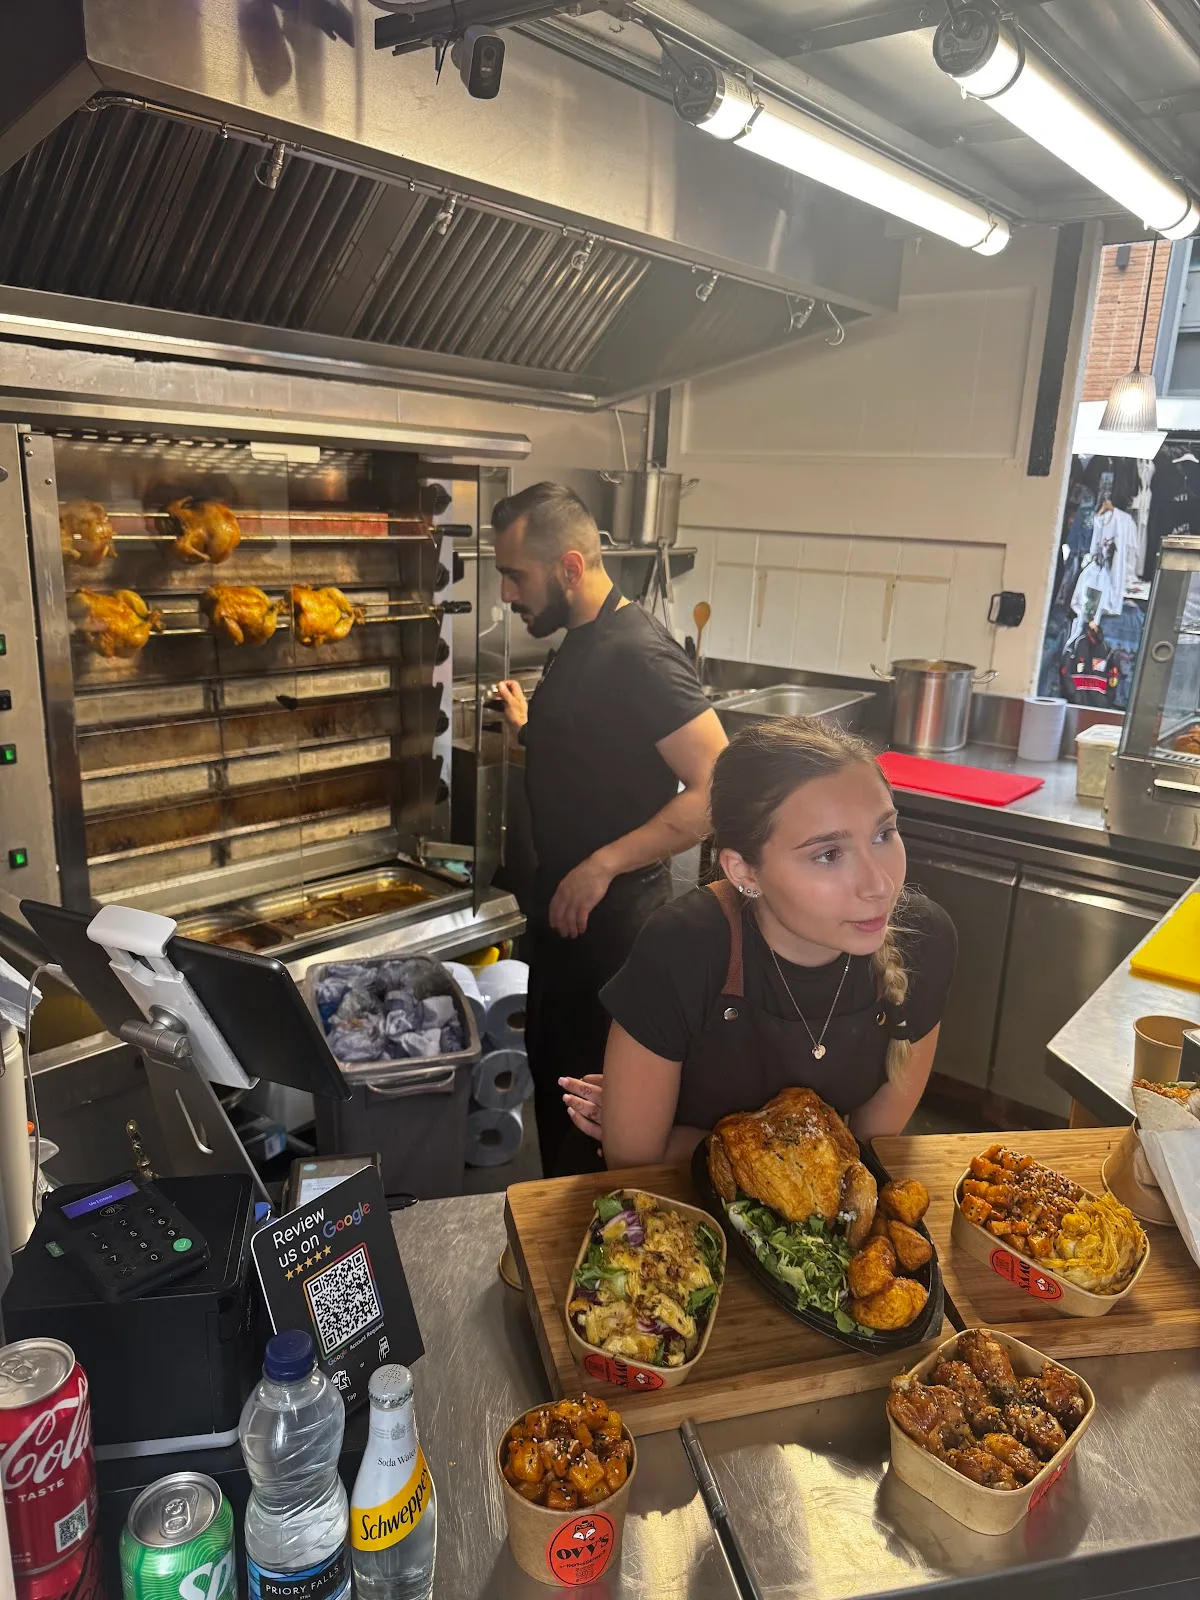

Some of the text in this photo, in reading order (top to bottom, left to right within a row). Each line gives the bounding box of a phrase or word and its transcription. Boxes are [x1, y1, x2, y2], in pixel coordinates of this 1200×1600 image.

[272, 1207, 325, 1249] Review
[278, 1201, 371, 1268] us on Google
[327, 1321, 385, 1366] Google Account Required
[346, 1392, 357, 1402] Tap
[377, 1448, 418, 1468] Soda Water
[18, 1478, 65, 1503] TASTE
[265, 1564, 339, 1596] PRIORY FALLS
